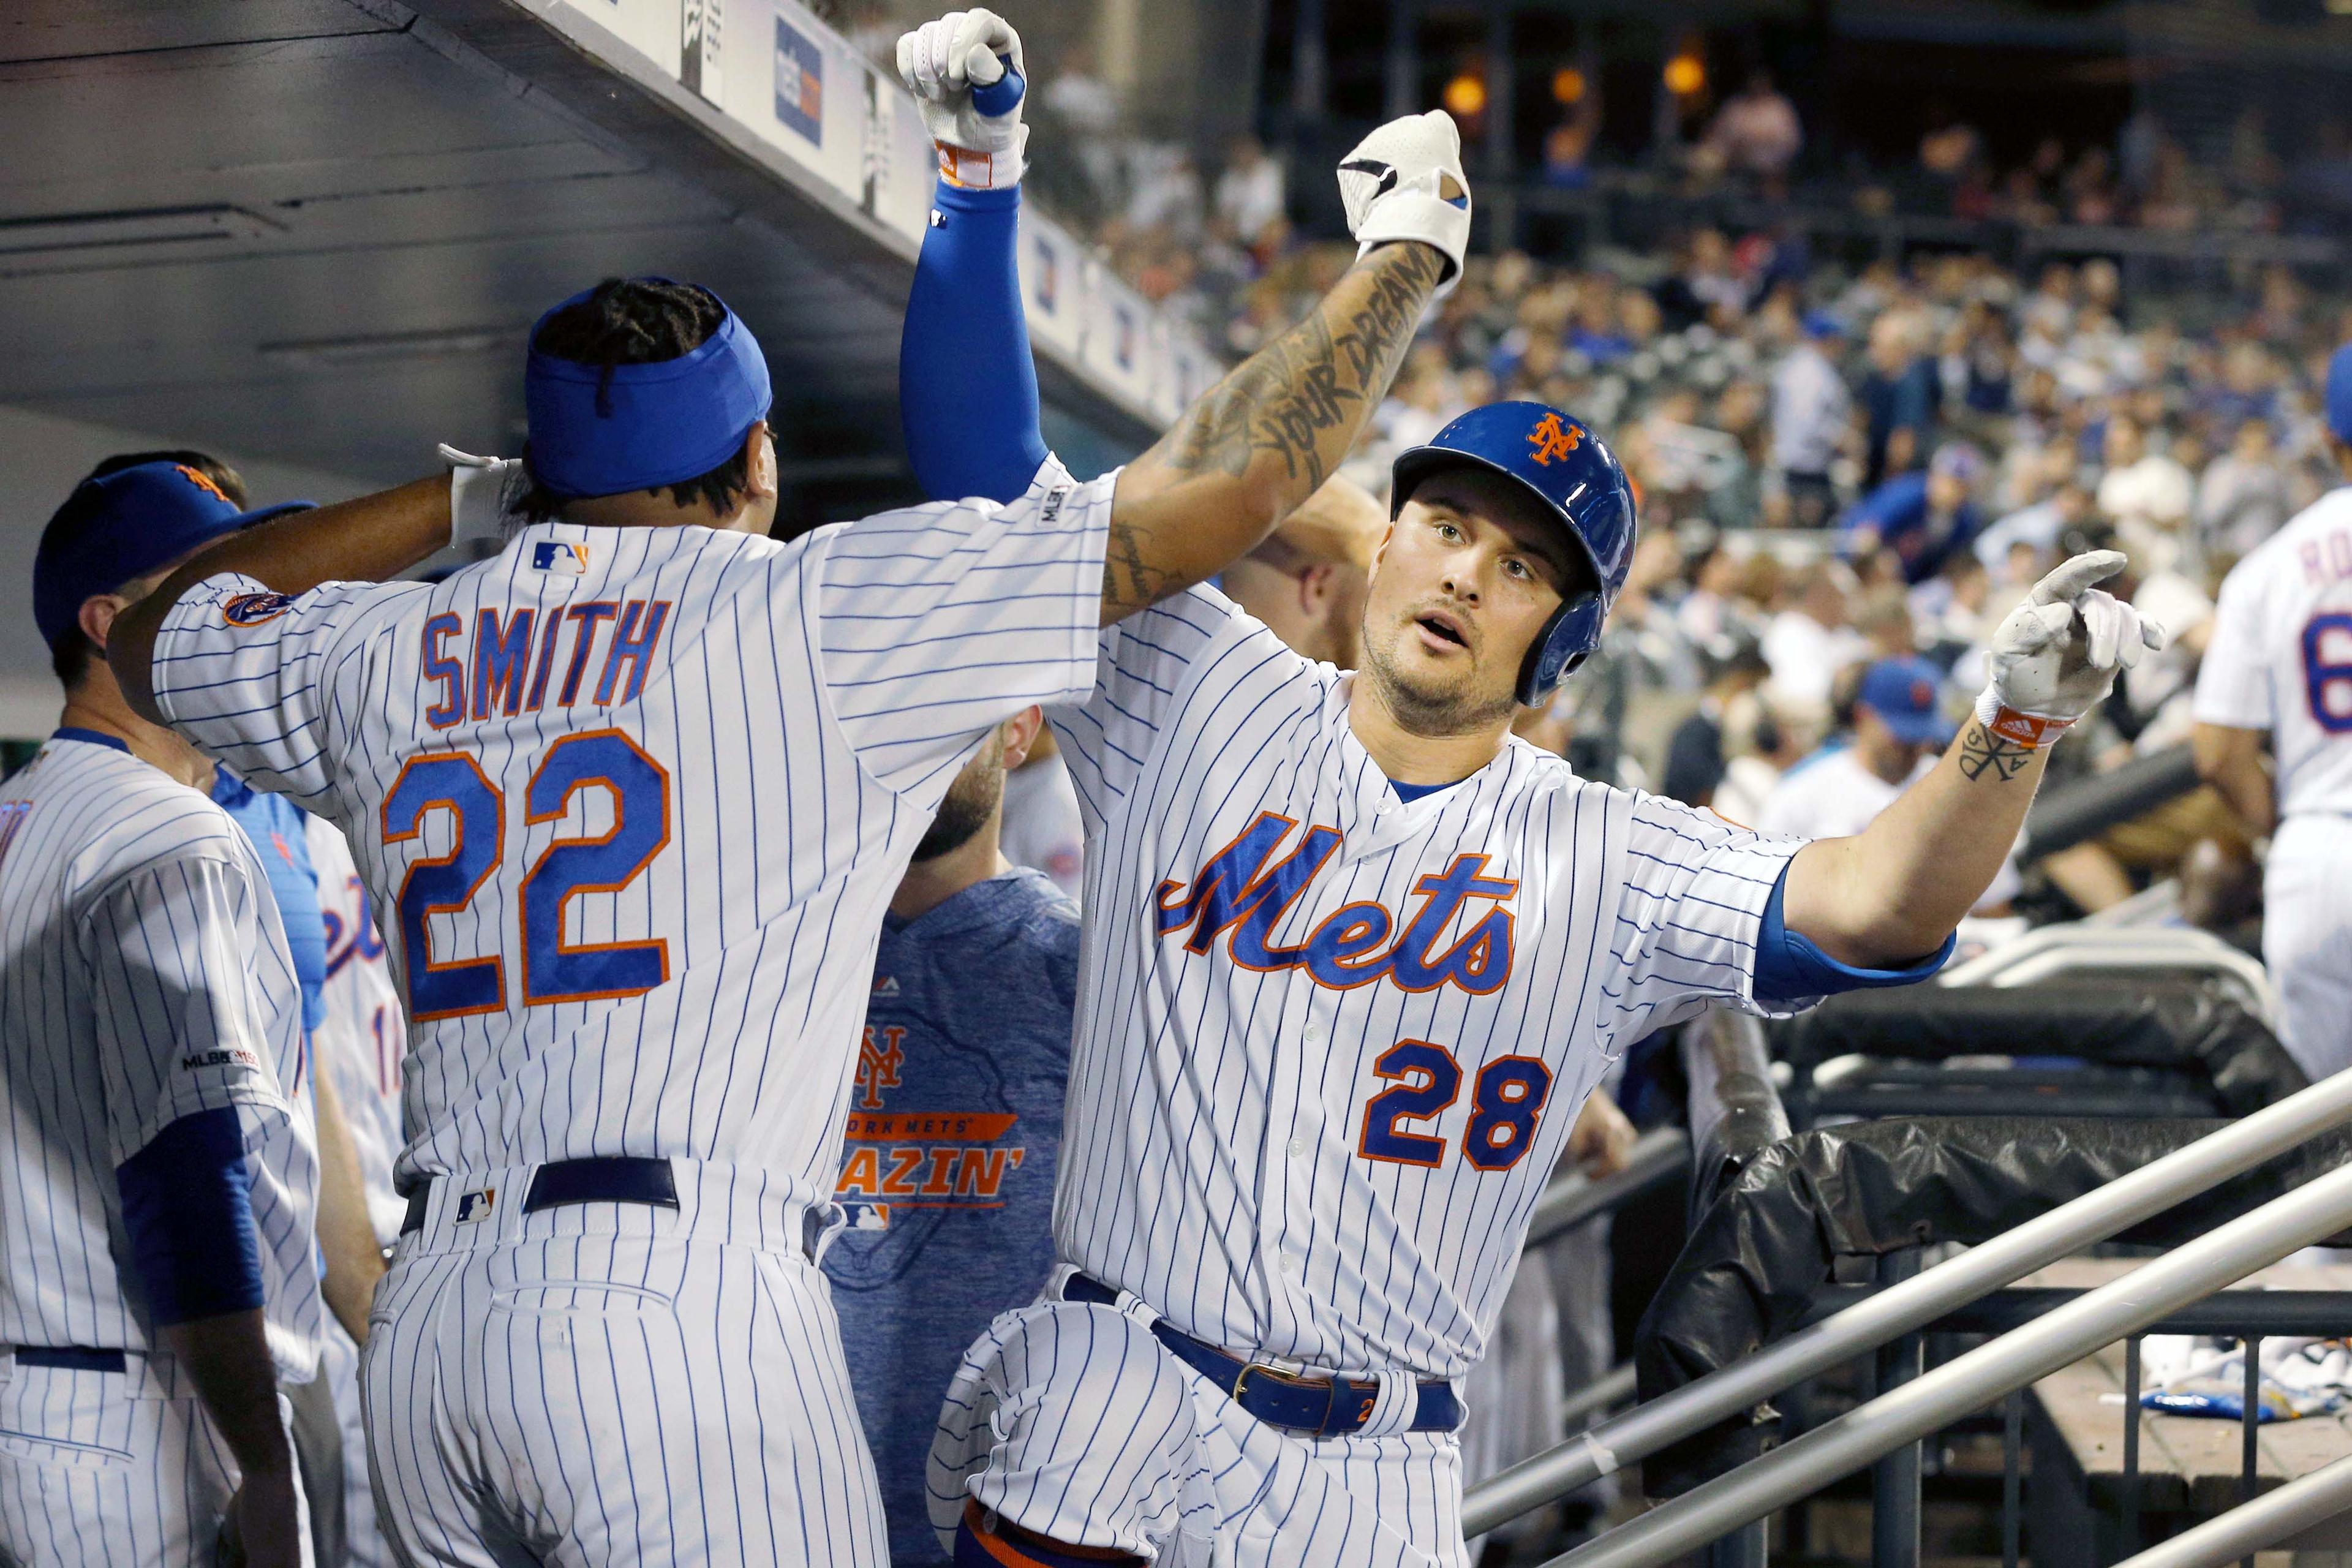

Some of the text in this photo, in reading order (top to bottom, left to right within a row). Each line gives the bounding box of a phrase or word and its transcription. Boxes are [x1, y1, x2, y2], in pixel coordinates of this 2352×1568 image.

[423, 600, 673, 731] SMITH
[380, 727, 671, 1022] 22
[1156, 810, 1519, 996] Mets
[846, 1119, 967, 1134] ORK METS
[1357, 1038, 1553, 1172] 28
[833, 1147, 1025, 1197] AZIN'
